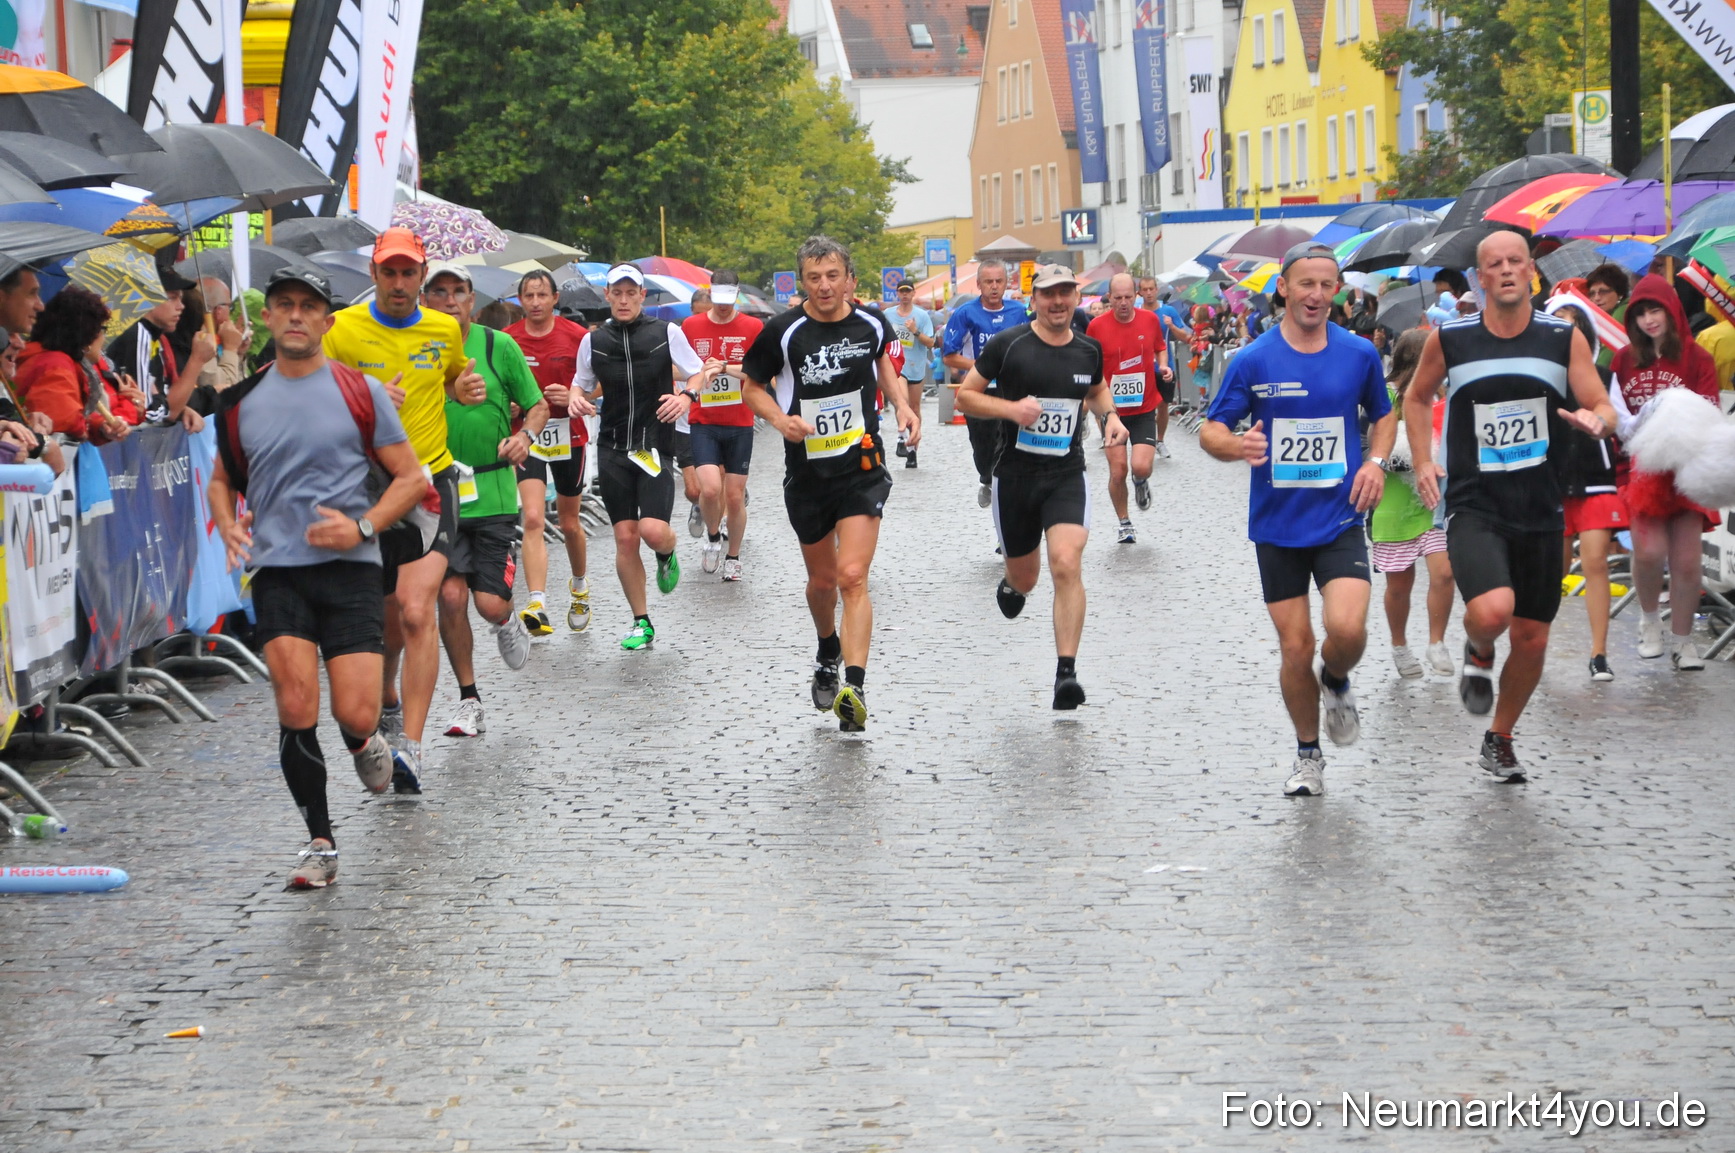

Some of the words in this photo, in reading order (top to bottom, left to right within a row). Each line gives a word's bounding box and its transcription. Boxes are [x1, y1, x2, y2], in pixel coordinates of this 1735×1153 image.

[1150, 36, 1164, 114] RUPPERT
[375, 40, 396, 167] Audi
[1266, 92, 1287, 118] HOTEL
[1587, 100, 1601, 117] H
[1066, 212, 1094, 239] KL
[358, 361, 385, 369] Bernd
[712, 377, 729, 392] 39
[1113, 381, 1143, 396] 2350
[711, 393, 732, 401] Markus
[815, 409, 852, 436] 612
[1483, 416, 1538, 447] 3221
[825, 437, 849, 449] Alfons
[1031, 437, 1063, 448] Günther
[1280, 436, 1339, 462] 2287
[10, 867, 112, 877] ReiseCenter
